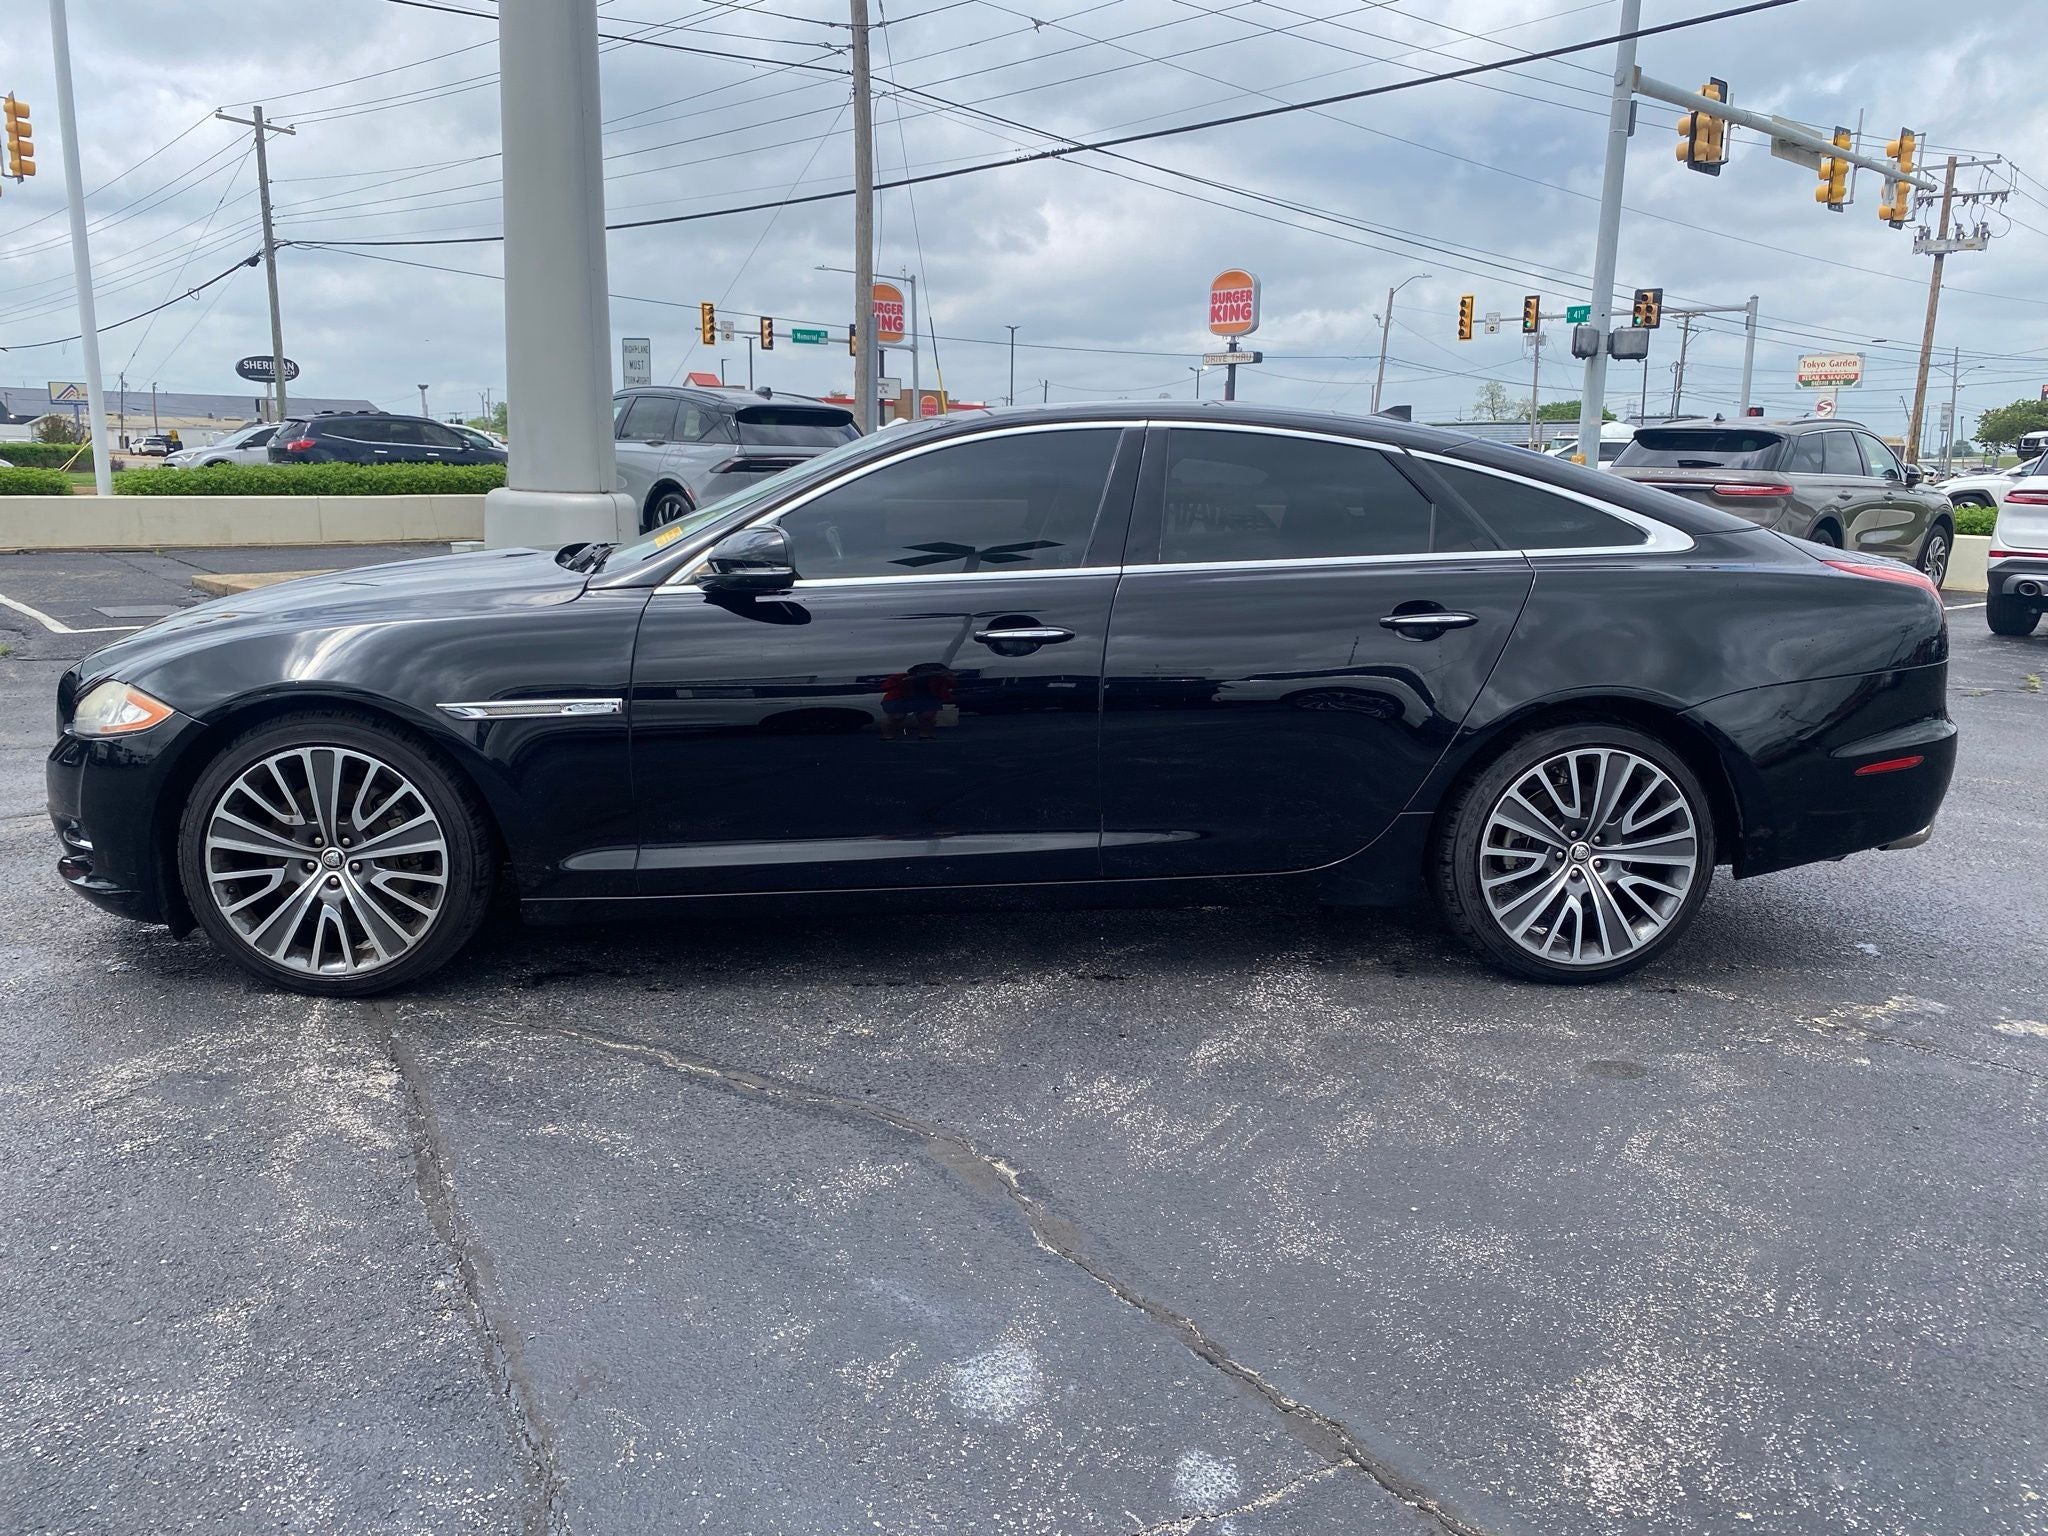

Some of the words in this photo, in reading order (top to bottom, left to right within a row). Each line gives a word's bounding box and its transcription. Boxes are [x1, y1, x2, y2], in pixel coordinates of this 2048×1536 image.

[1211, 290, 1252, 305] BURGER
[873, 302, 904, 316] URGER
[1210, 303, 1252, 323] KING
[1205, 354, 1228, 364] DRIVE
[1230, 352, 1253, 362] THRU
[243, 360, 294, 370] SHERIAN
[629, 360, 644, 370] MUST
[1802, 360, 1826, 370] Tokyo
[1830, 360, 1857, 368] Garden
